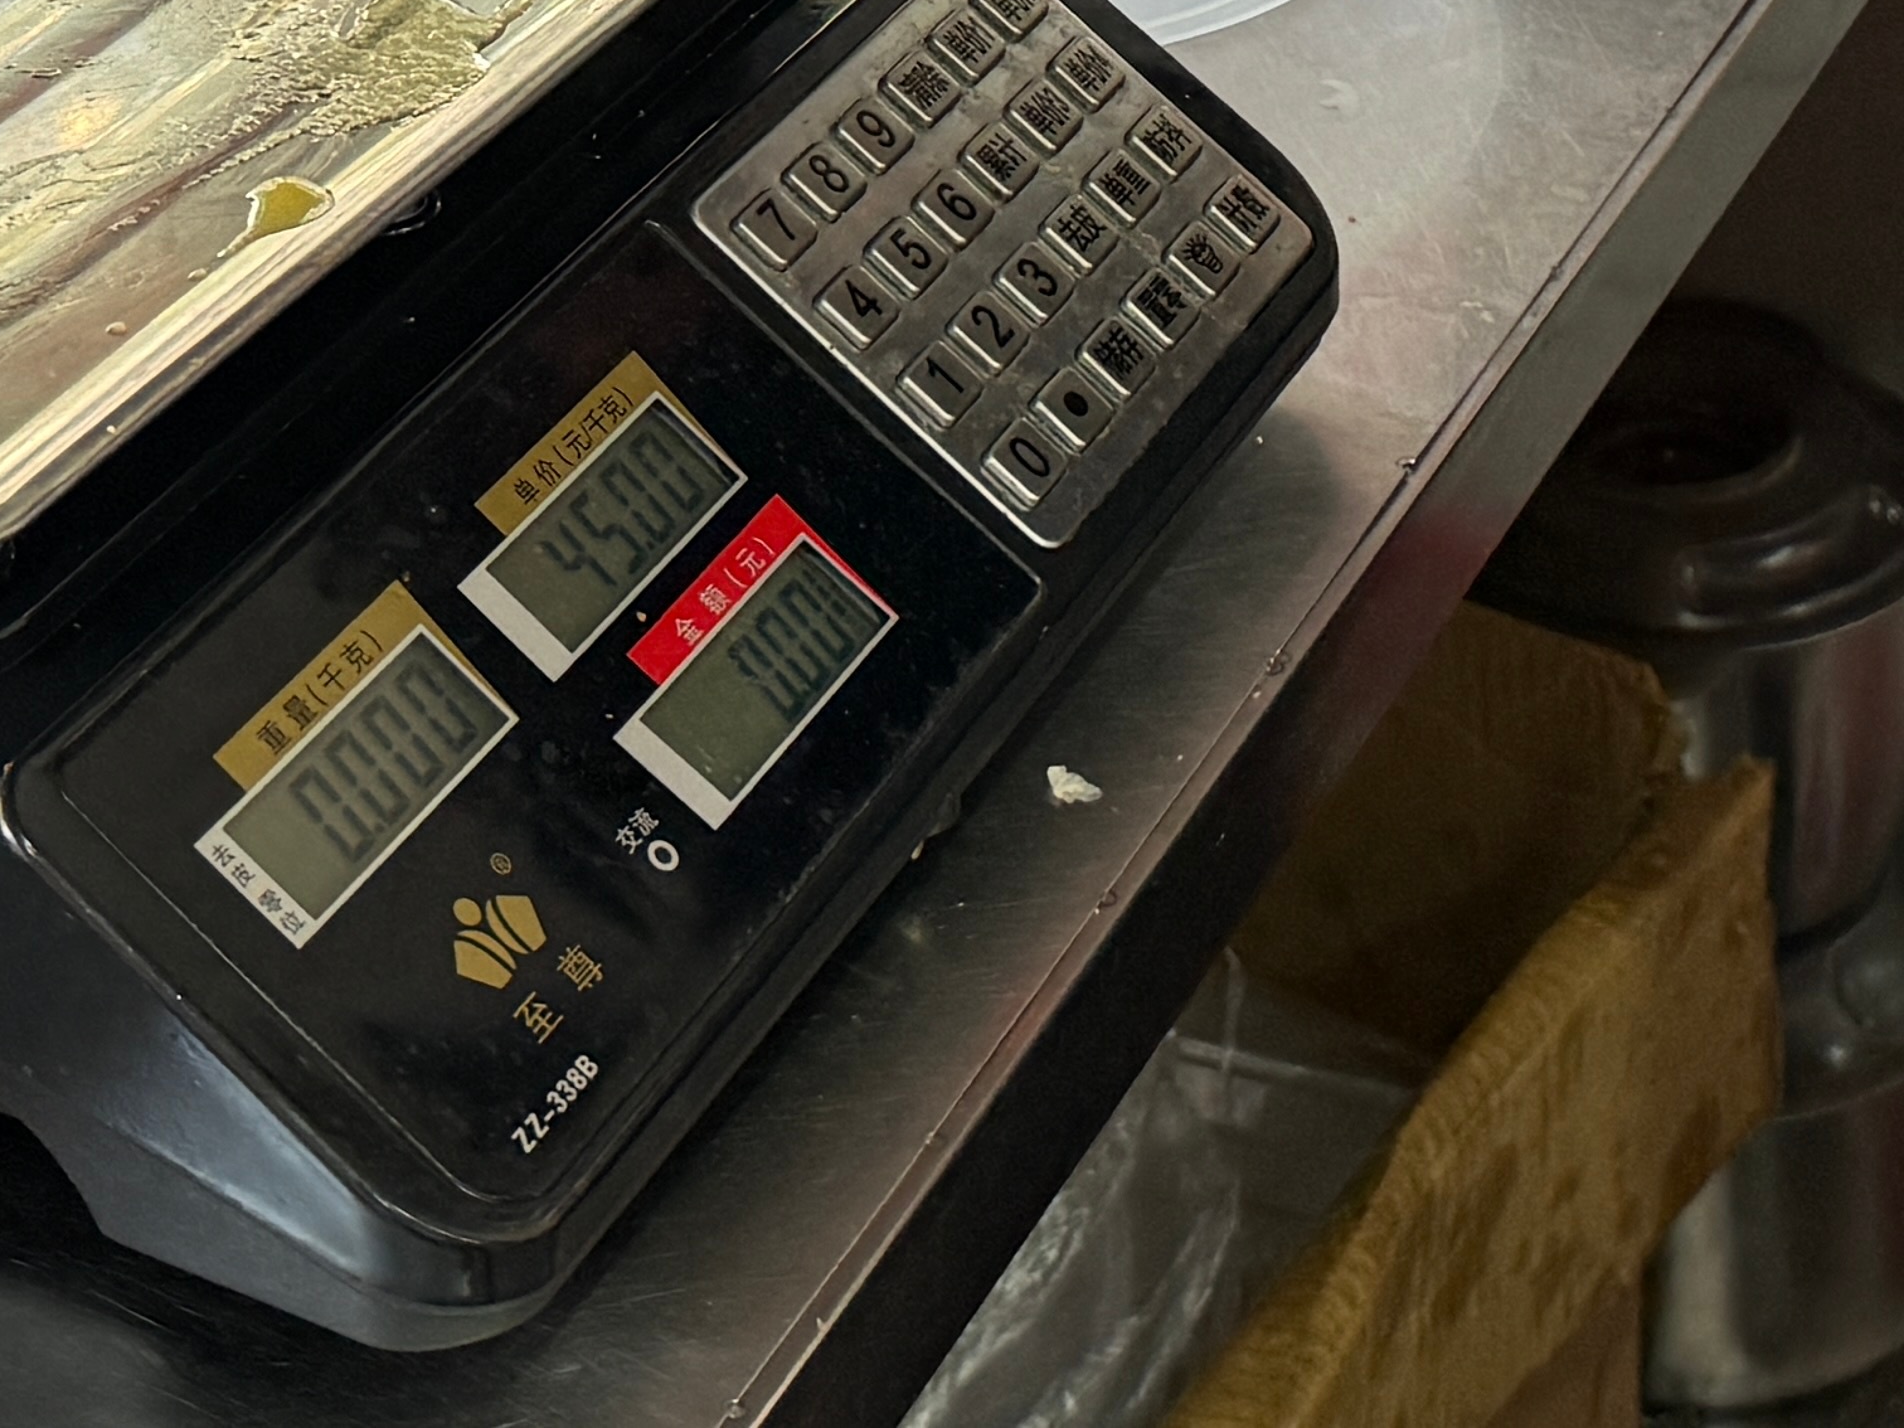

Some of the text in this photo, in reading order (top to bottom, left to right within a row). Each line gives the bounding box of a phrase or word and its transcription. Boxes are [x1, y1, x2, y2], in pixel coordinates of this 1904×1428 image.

[898, 60, 950, 110] 清除
[755, 109, 896, 241] 7 8 9
[975, 131, 1028, 182] 累计
[1098, 157, 1152, 207] 单重
[844, 182, 978, 318] 4 5 6
[1057, 203, 1108, 253] 去皮
[1136, 273, 1188, 325] 置零
[925, 257, 1059, 394] 1 2 3
[1092, 325, 1145, 381] 储存
[1008, 436, 1051, 478] 0
[614, 806, 661, 855] 交流
[512, 944, 606, 1045] 至尊
[509, 1053, 600, 1156] ZZ-338B
